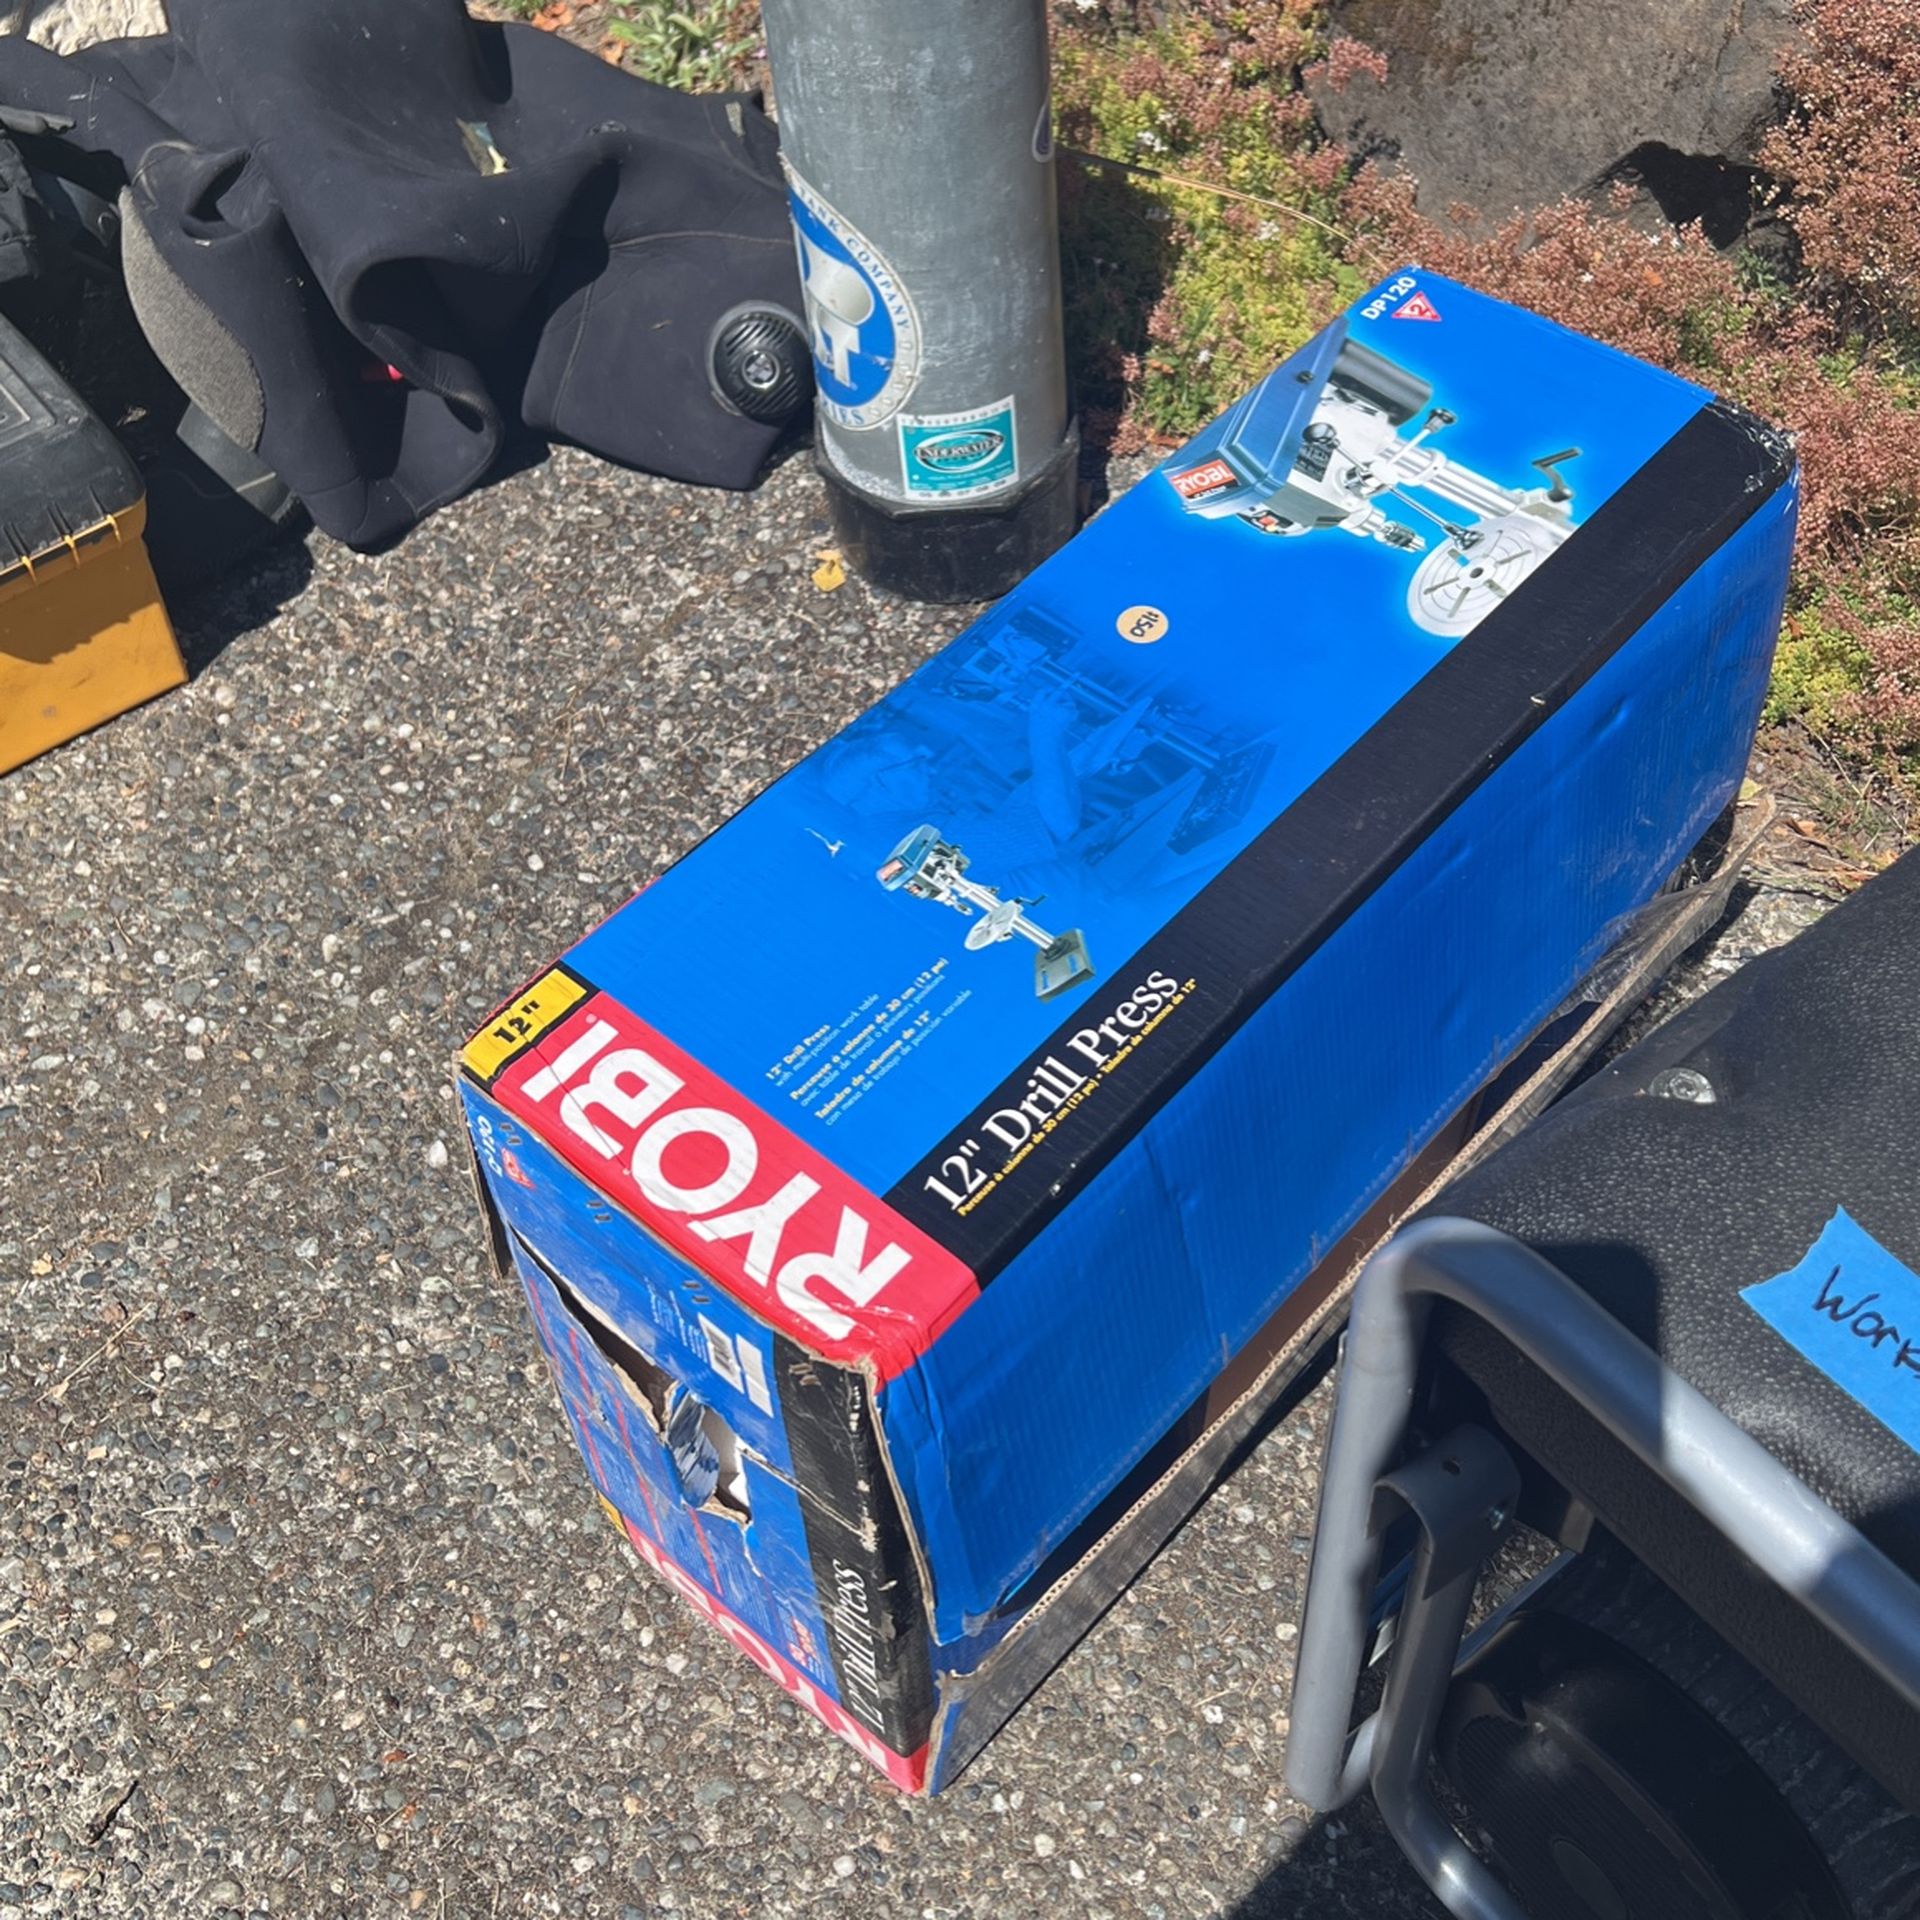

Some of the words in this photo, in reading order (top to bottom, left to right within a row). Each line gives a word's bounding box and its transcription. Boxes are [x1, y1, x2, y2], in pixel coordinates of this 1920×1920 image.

[847, 238, 910, 331] COMPANY
[1360, 276, 1416, 320] DP120
[1172, 465, 1231, 495] RYOBI
[493, 1000, 540, 1044] 12"
[765, 1063, 782, 1080] 12"
[783, 1044, 806, 1065] Drill
[803, 1024, 830, 1047] Press
[924, 1139, 987, 1210] 12"
[981, 1056, 1089, 1151] Drill
[1067, 971, 1179, 1067] Press
[520, 1019, 913, 1340] RYOBI
[1812, 1264, 1920, 1380] Work
[833, 1558, 874, 1644] Press
[834, 1624, 881, 1698] Drill
